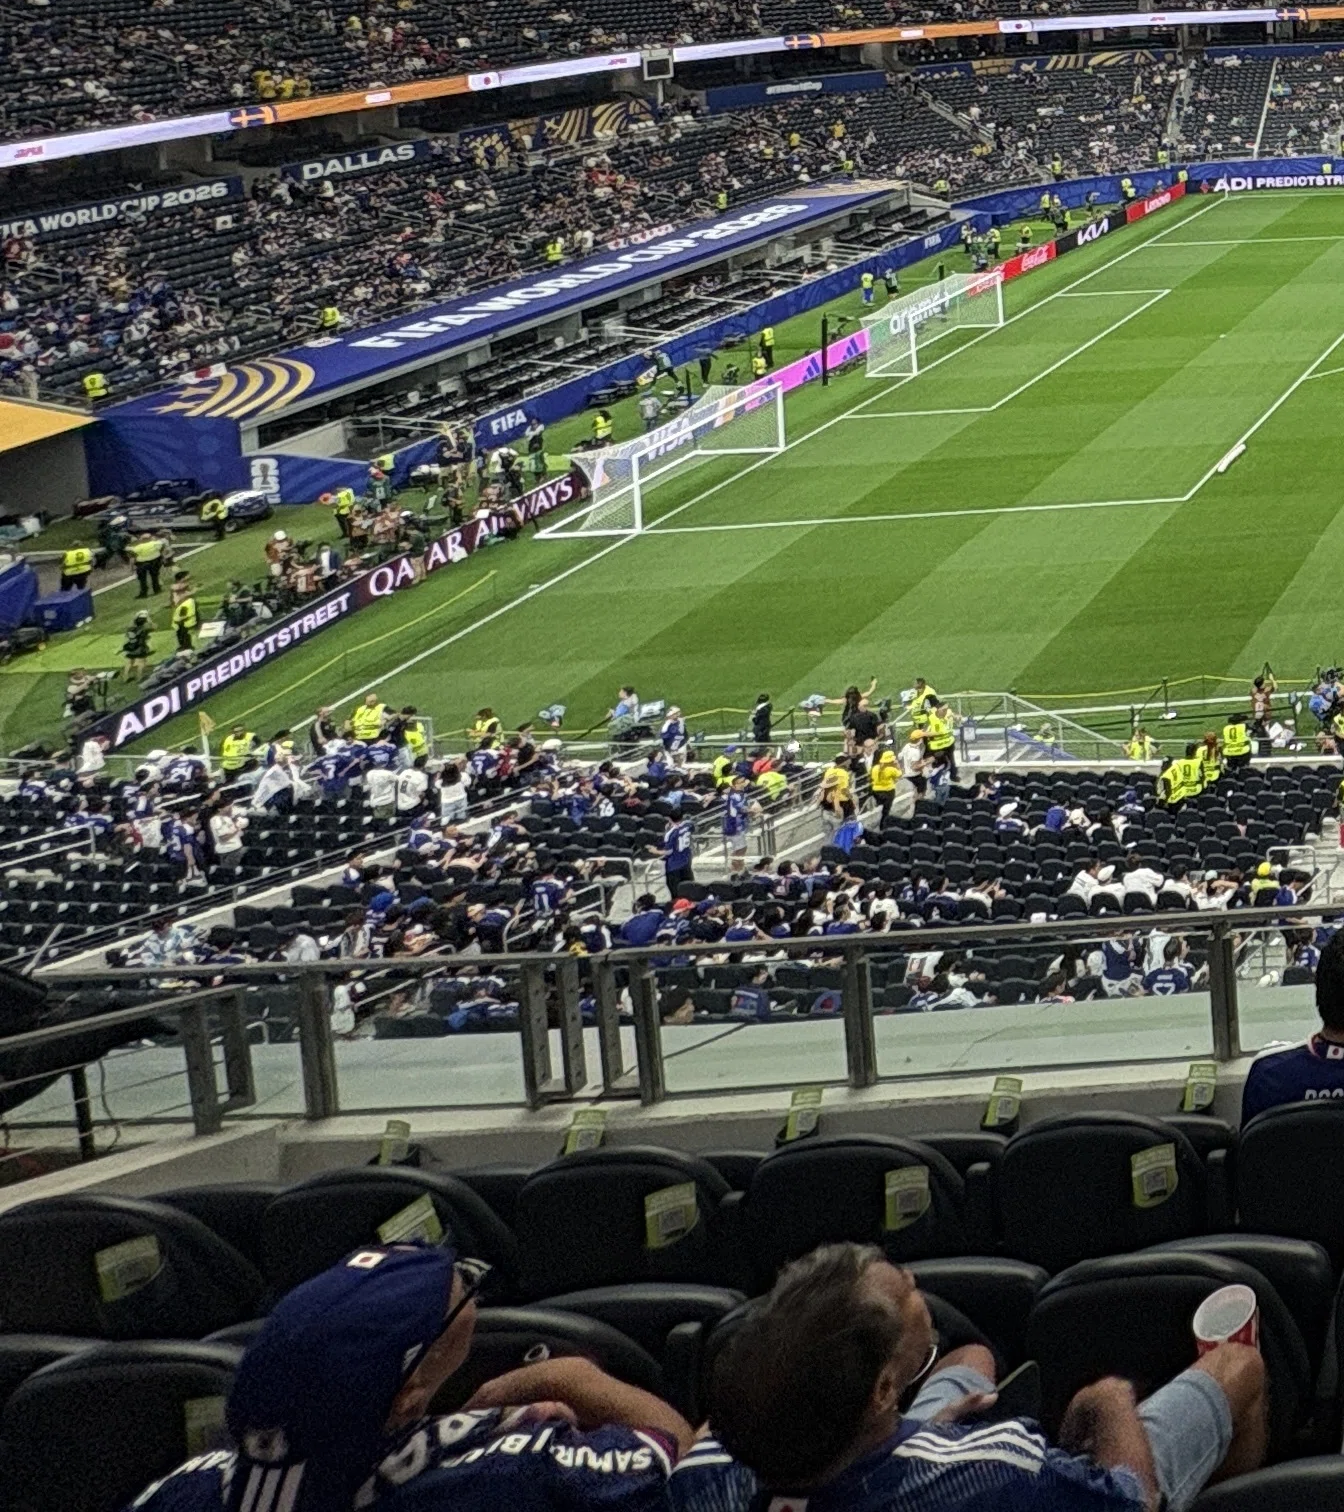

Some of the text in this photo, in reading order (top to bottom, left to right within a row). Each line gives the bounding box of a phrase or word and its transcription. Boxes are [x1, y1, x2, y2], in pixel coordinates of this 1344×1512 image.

[303, 143, 416, 181] DALLAS
[1213, 175, 1253, 192] ADI
[40, 203, 118, 232] WORLD
[119, 194, 161, 216] CUP
[161, 181, 229, 208] 2026
[1144, 190, 1172, 212] Lenovo
[924, 232, 942, 249] FIFA
[1076, 217, 1110, 246] KIA
[348, 203, 811, 348] FIFA WORLD CUP 2026
[491, 409, 528, 436] FIFA
[369, 531, 464, 598] QAAR
[114, 591, 352, 748] ADI PREDICTSTREET
[170, 765, 194, 781] 24
[531, 1427, 653, 1474] SAMURI
